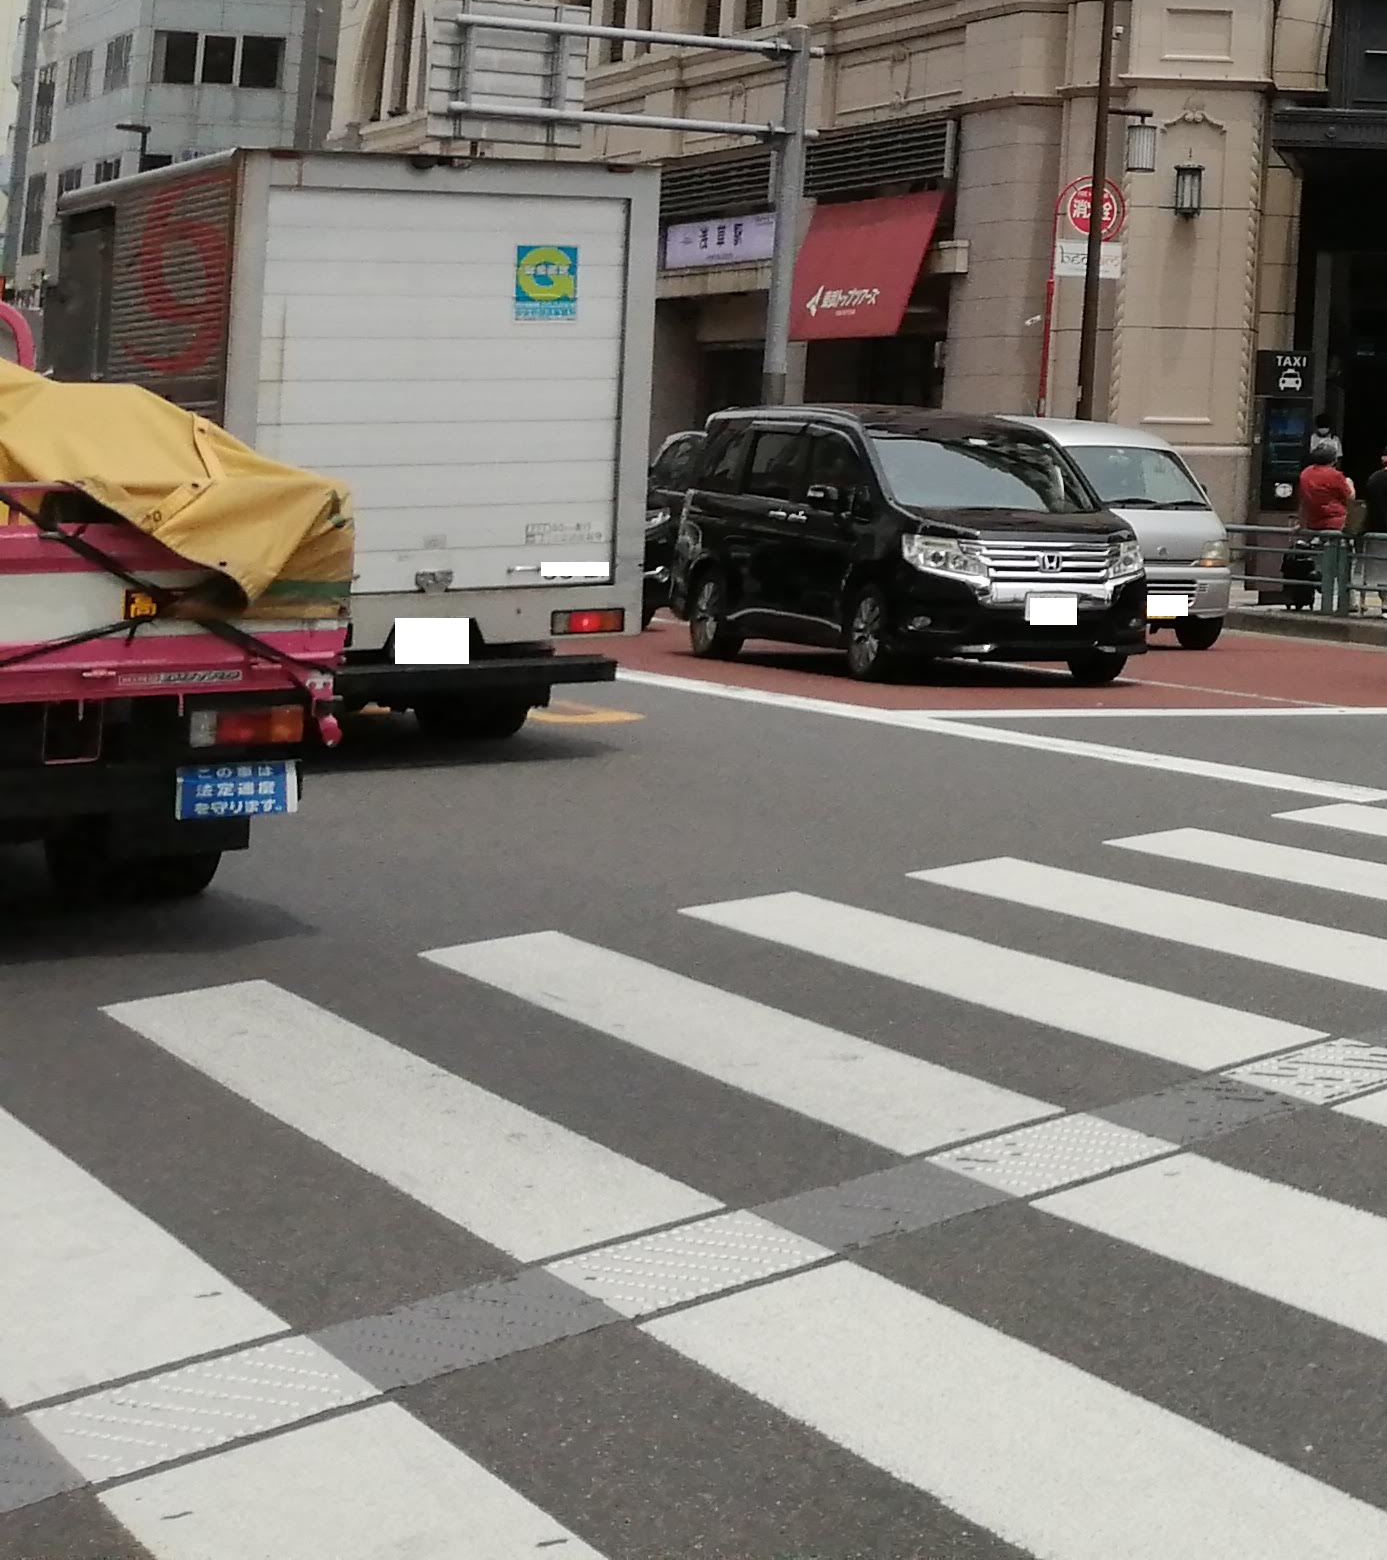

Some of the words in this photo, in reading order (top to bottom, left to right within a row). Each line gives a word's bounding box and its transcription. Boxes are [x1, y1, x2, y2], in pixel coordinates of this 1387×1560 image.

[1276, 356, 1307, 368] TAXI
[195, 780, 275, 797] 法定速度
